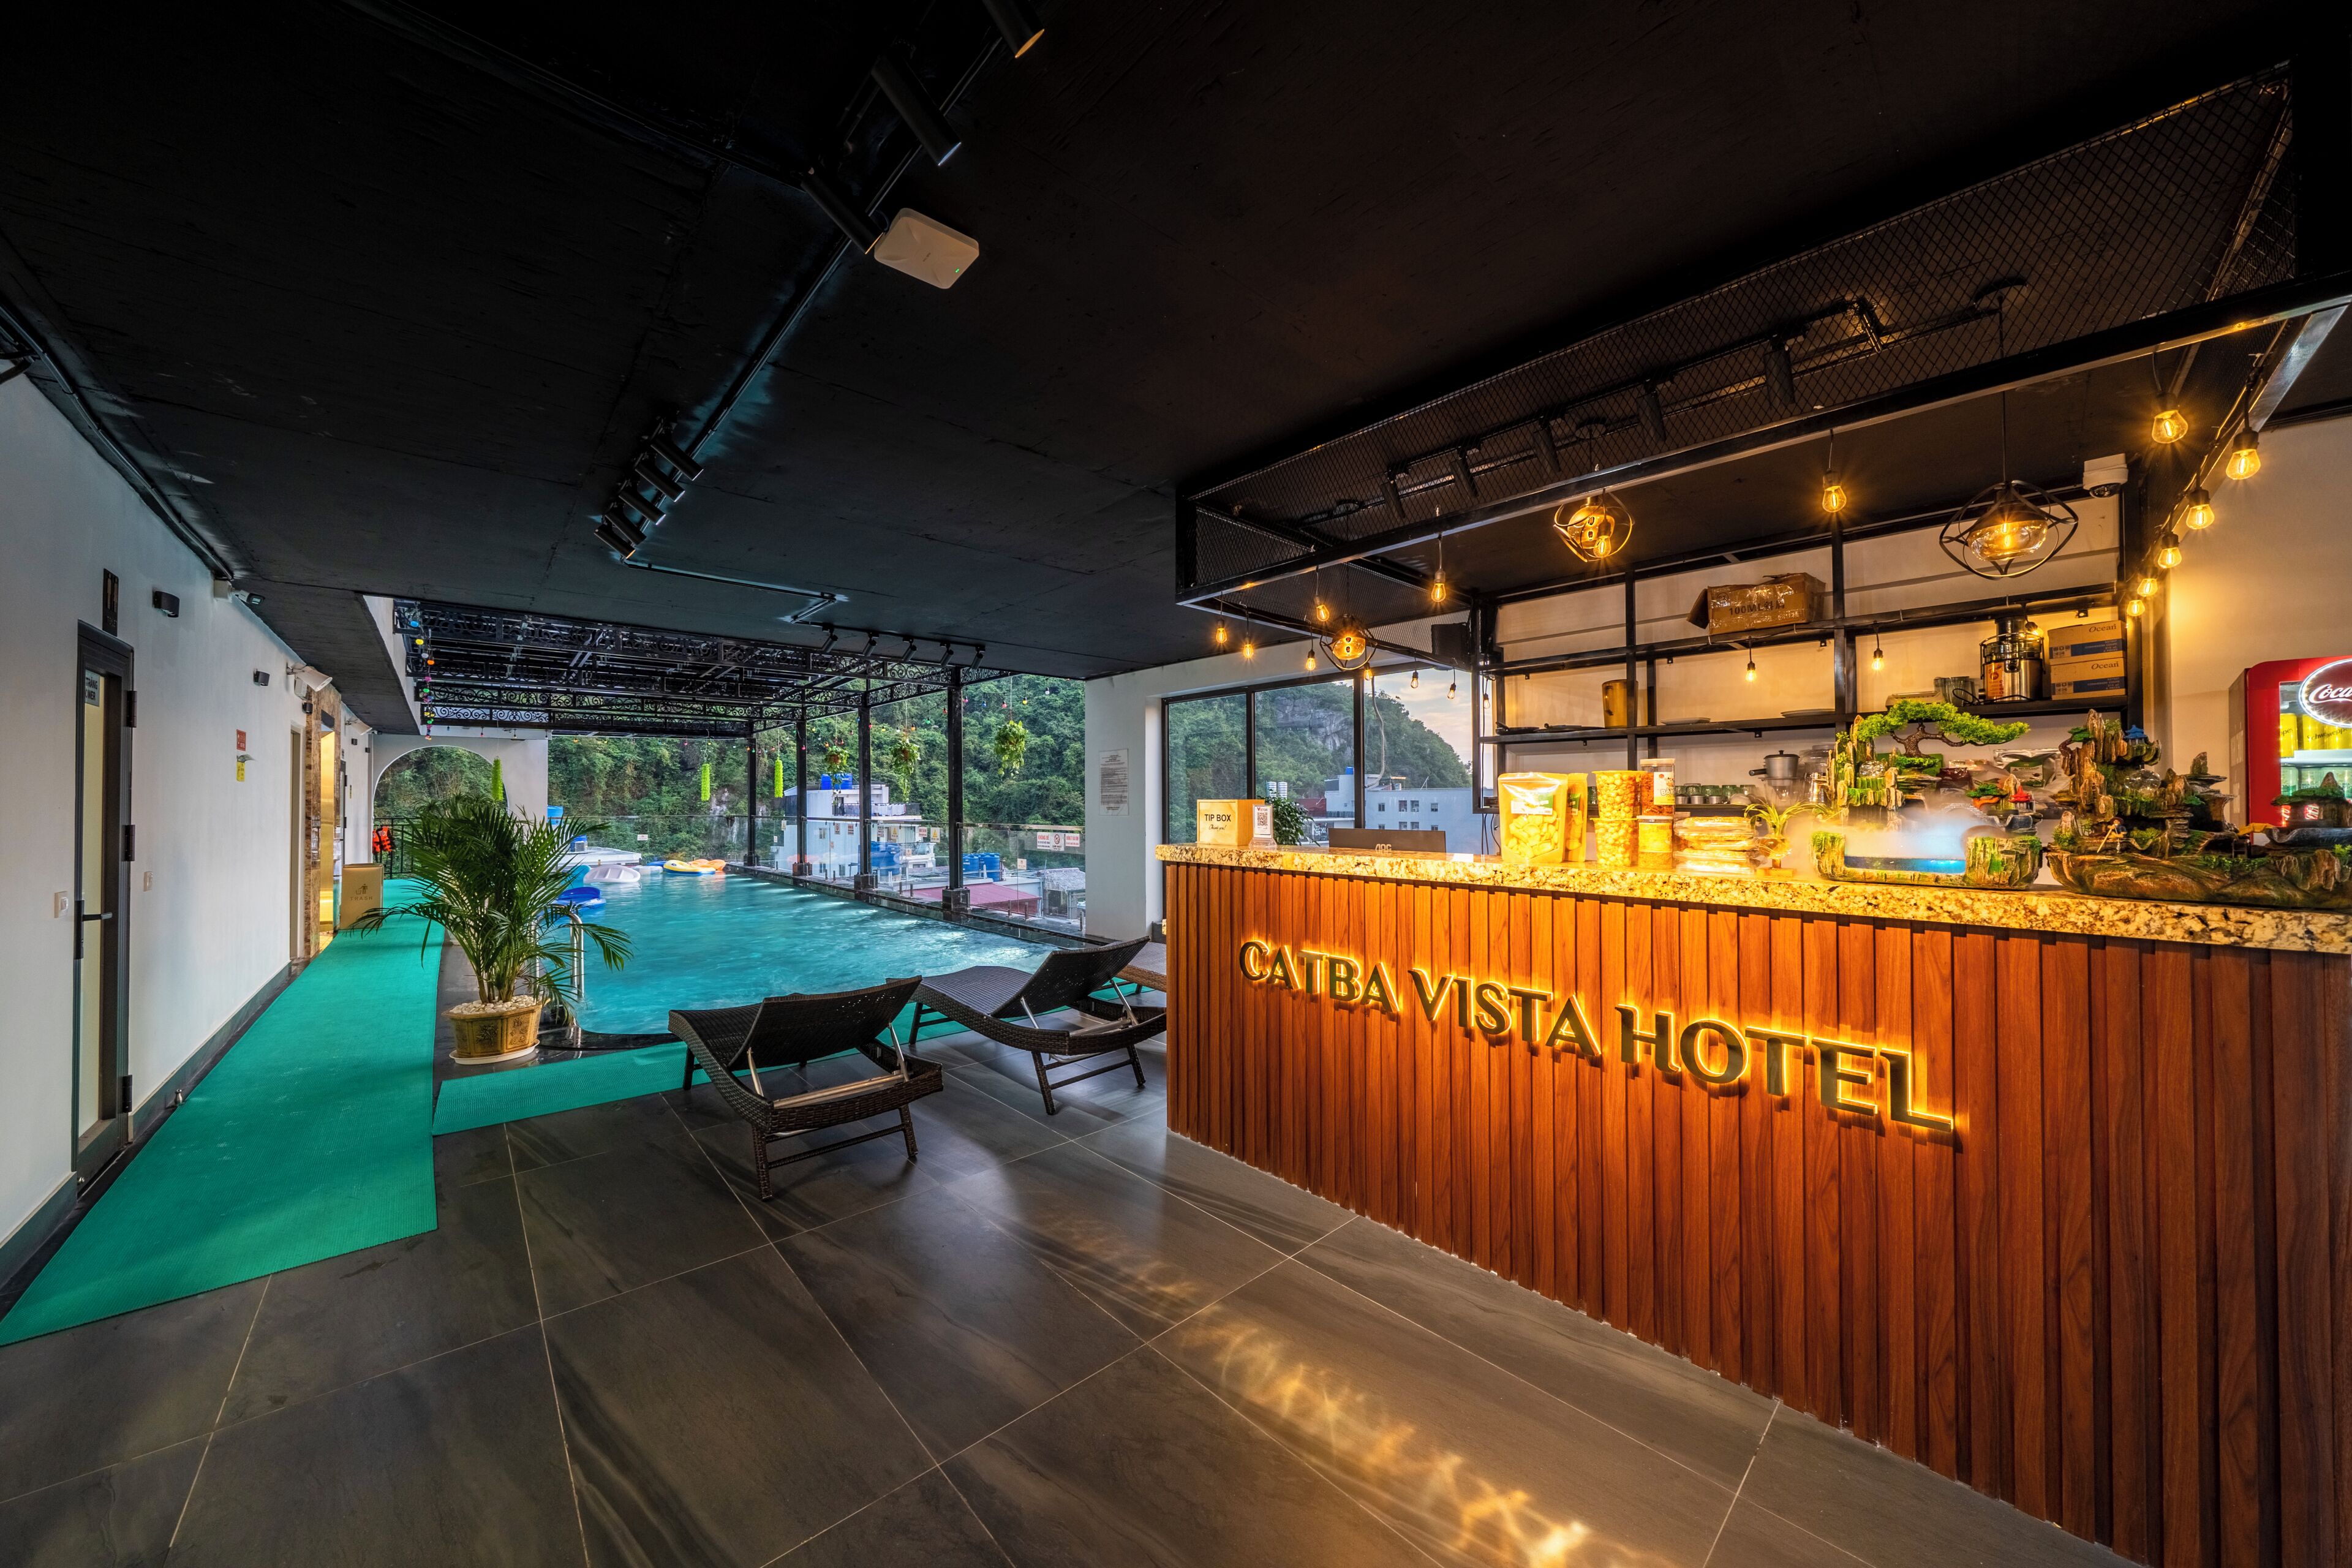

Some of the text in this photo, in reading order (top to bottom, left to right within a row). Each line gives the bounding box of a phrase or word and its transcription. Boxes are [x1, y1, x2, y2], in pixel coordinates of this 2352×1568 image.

[2089, 624, 2117, 633] Ocean
[2091, 661, 2119, 670] Ocean
[1238, 940, 1954, 1133] CATBA VISTA HOTEL
